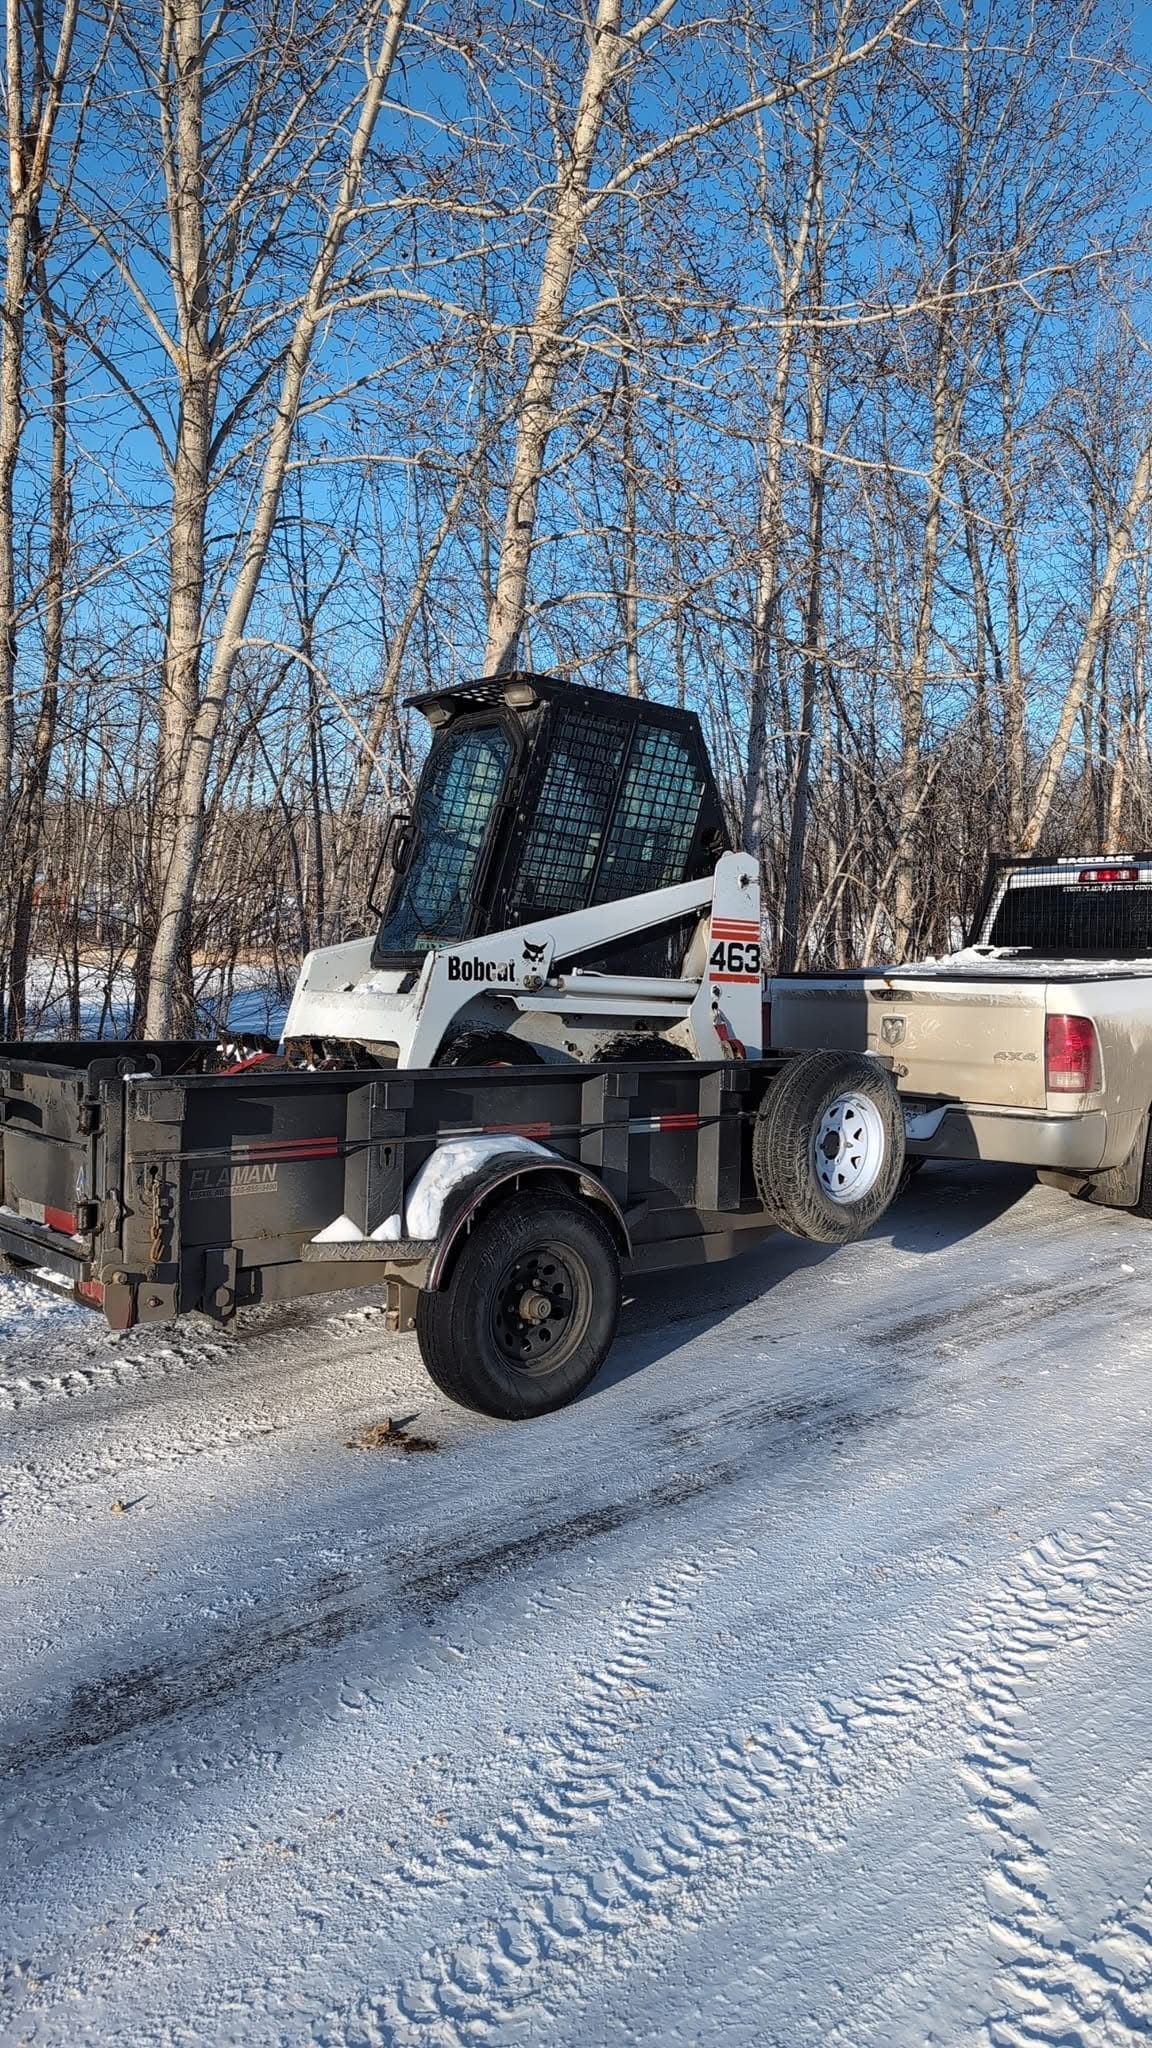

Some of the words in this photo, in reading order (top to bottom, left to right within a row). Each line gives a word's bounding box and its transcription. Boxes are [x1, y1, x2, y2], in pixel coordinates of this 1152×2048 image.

[1057, 855, 1136, 864] BACKRACK
[448, 955, 516, 982] Bobcat
[709, 941, 761, 974] 463
[190, 1163, 278, 1190] FLAMAN
